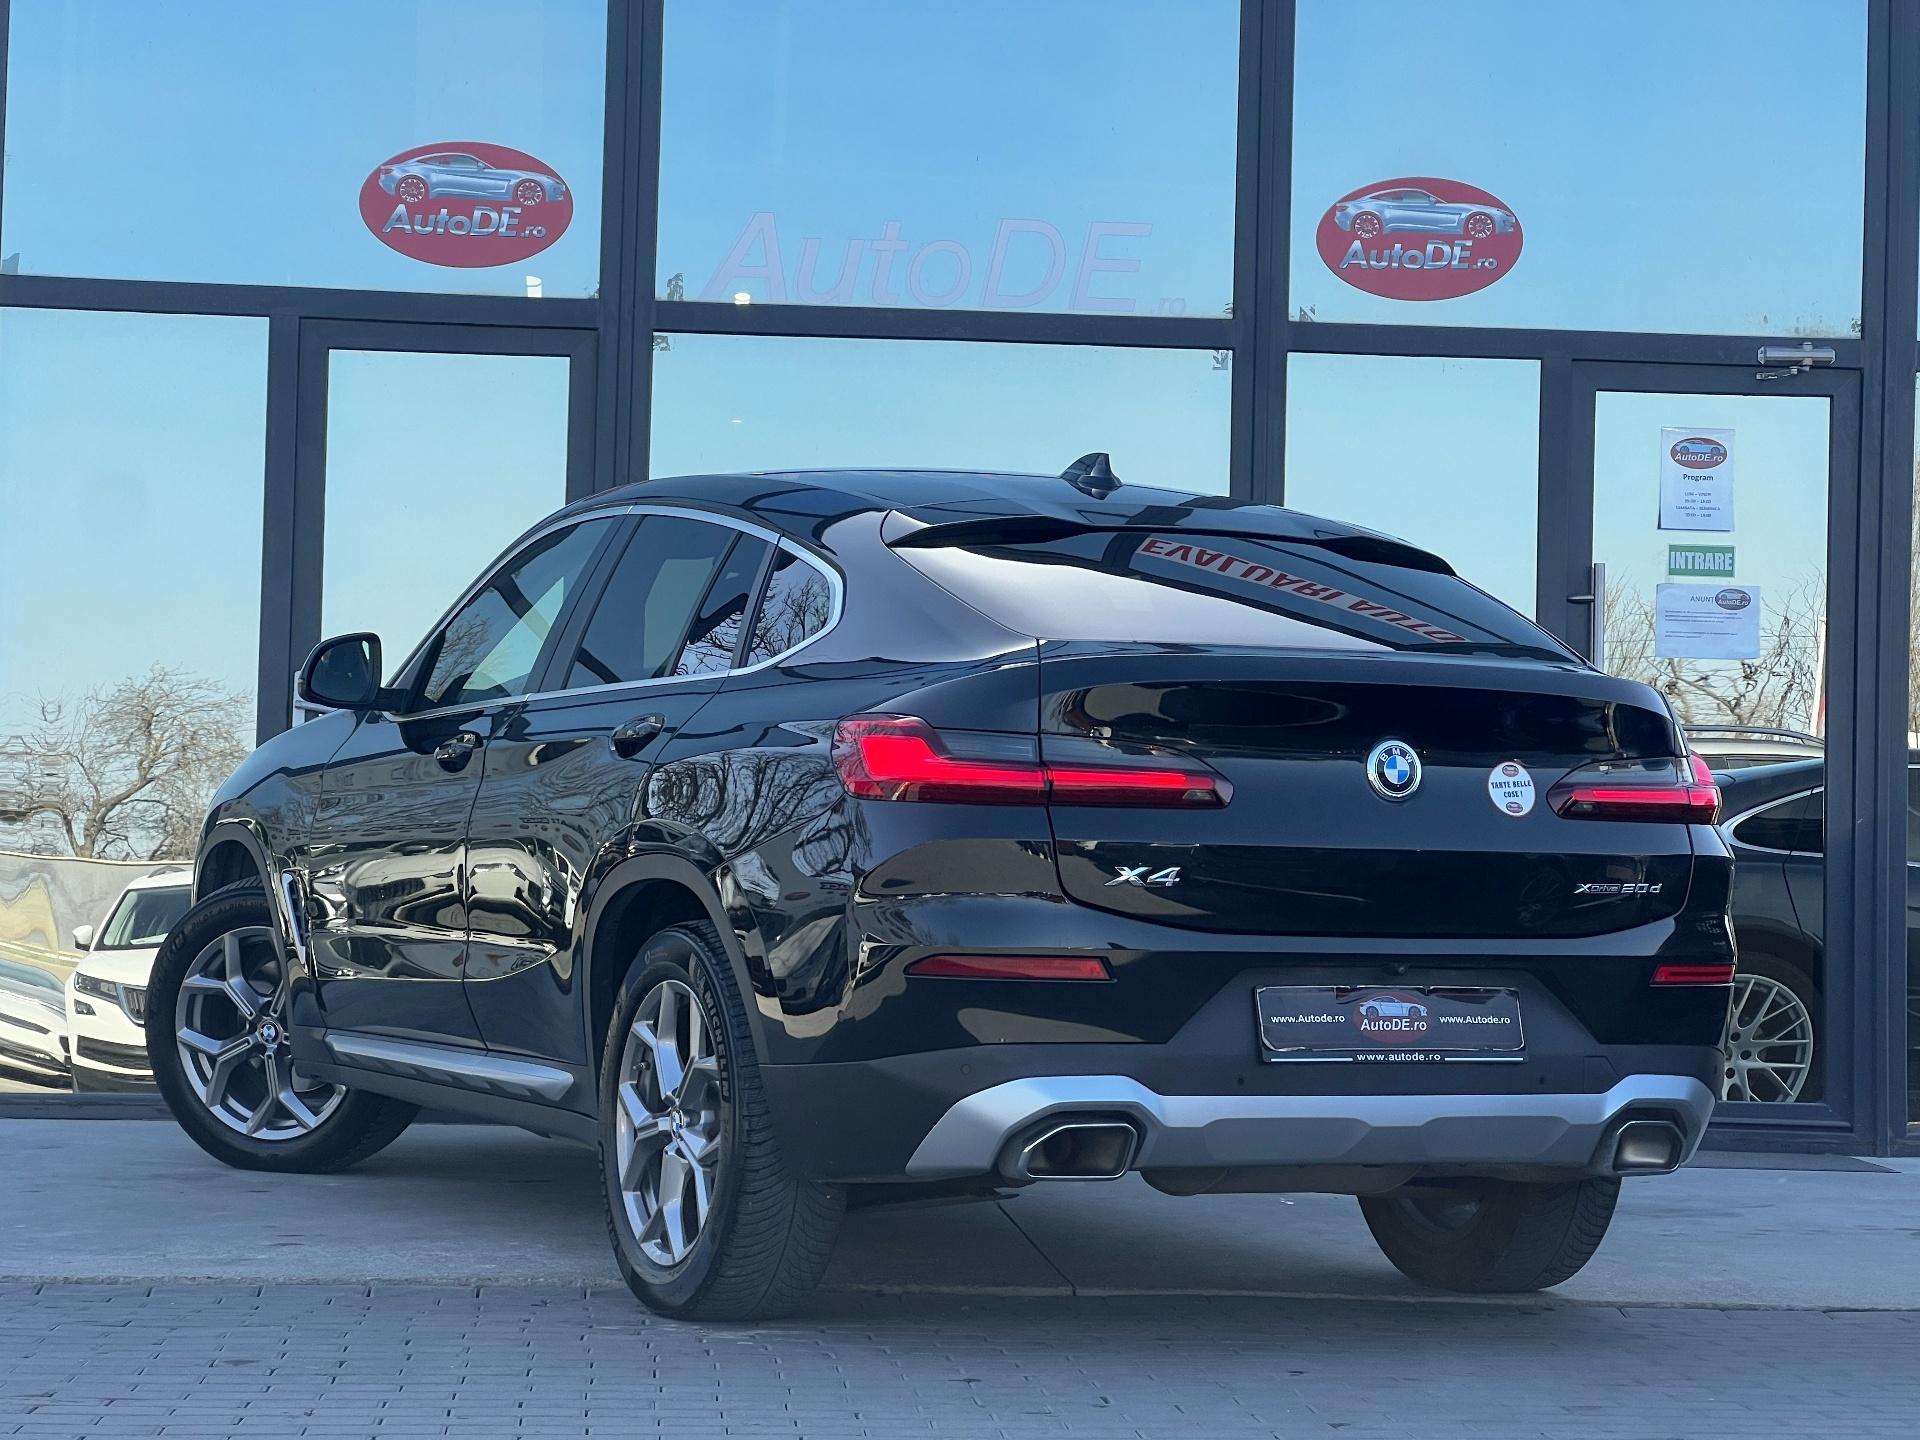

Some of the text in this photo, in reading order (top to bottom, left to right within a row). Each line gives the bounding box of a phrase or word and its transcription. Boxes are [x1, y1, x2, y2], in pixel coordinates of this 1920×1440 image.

[382, 203, 546, 238] AutoDE.ro
[1338, 239, 1498, 271] AutoDE.ro
[1674, 453, 1723, 462] AutoDE.ro
[1683, 474, 1714, 482] Program
[1670, 551, 1733, 571] INTRARE
[1380, 748, 1413, 764] BMW
[1512, 780, 1532, 788] BELLE
[1104, 866, 1181, 887] X4
[1270, 1013, 1345, 1023] www.Autode.ro
[1360, 1018, 1427, 1032] AutoDE.ro
[1438, 1014, 1511, 1025] www.Autode.ro
[703, 990, 731, 1097] MICHELIN
[1356, 1052, 1441, 1062] www.autode.ro
